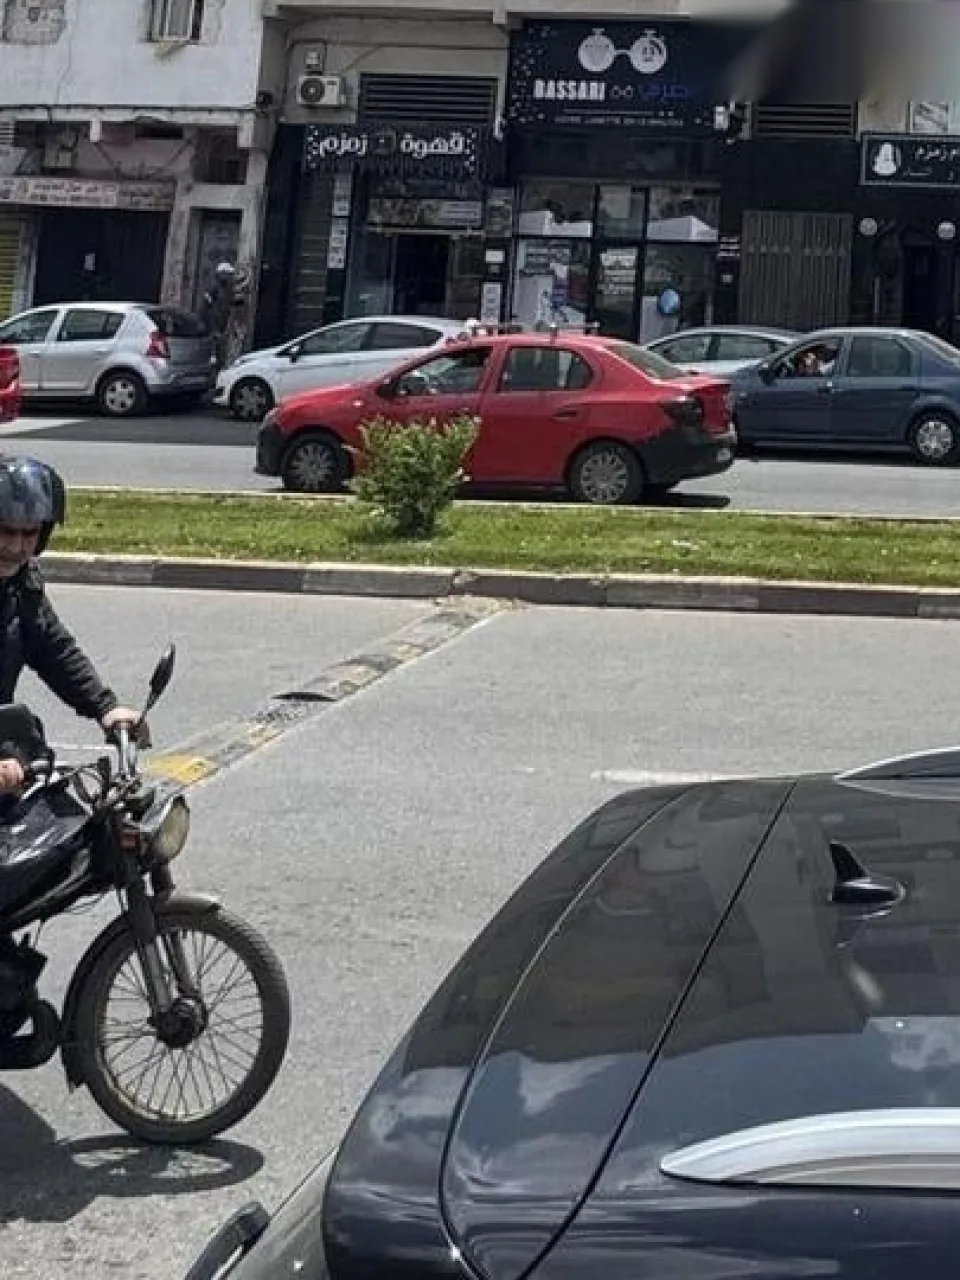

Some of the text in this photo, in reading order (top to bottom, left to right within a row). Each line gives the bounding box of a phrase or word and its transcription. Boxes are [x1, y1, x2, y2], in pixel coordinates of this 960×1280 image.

[320, 133, 465, 159] قهوة زمزم
[914, 145, 948, 162] زمزم
